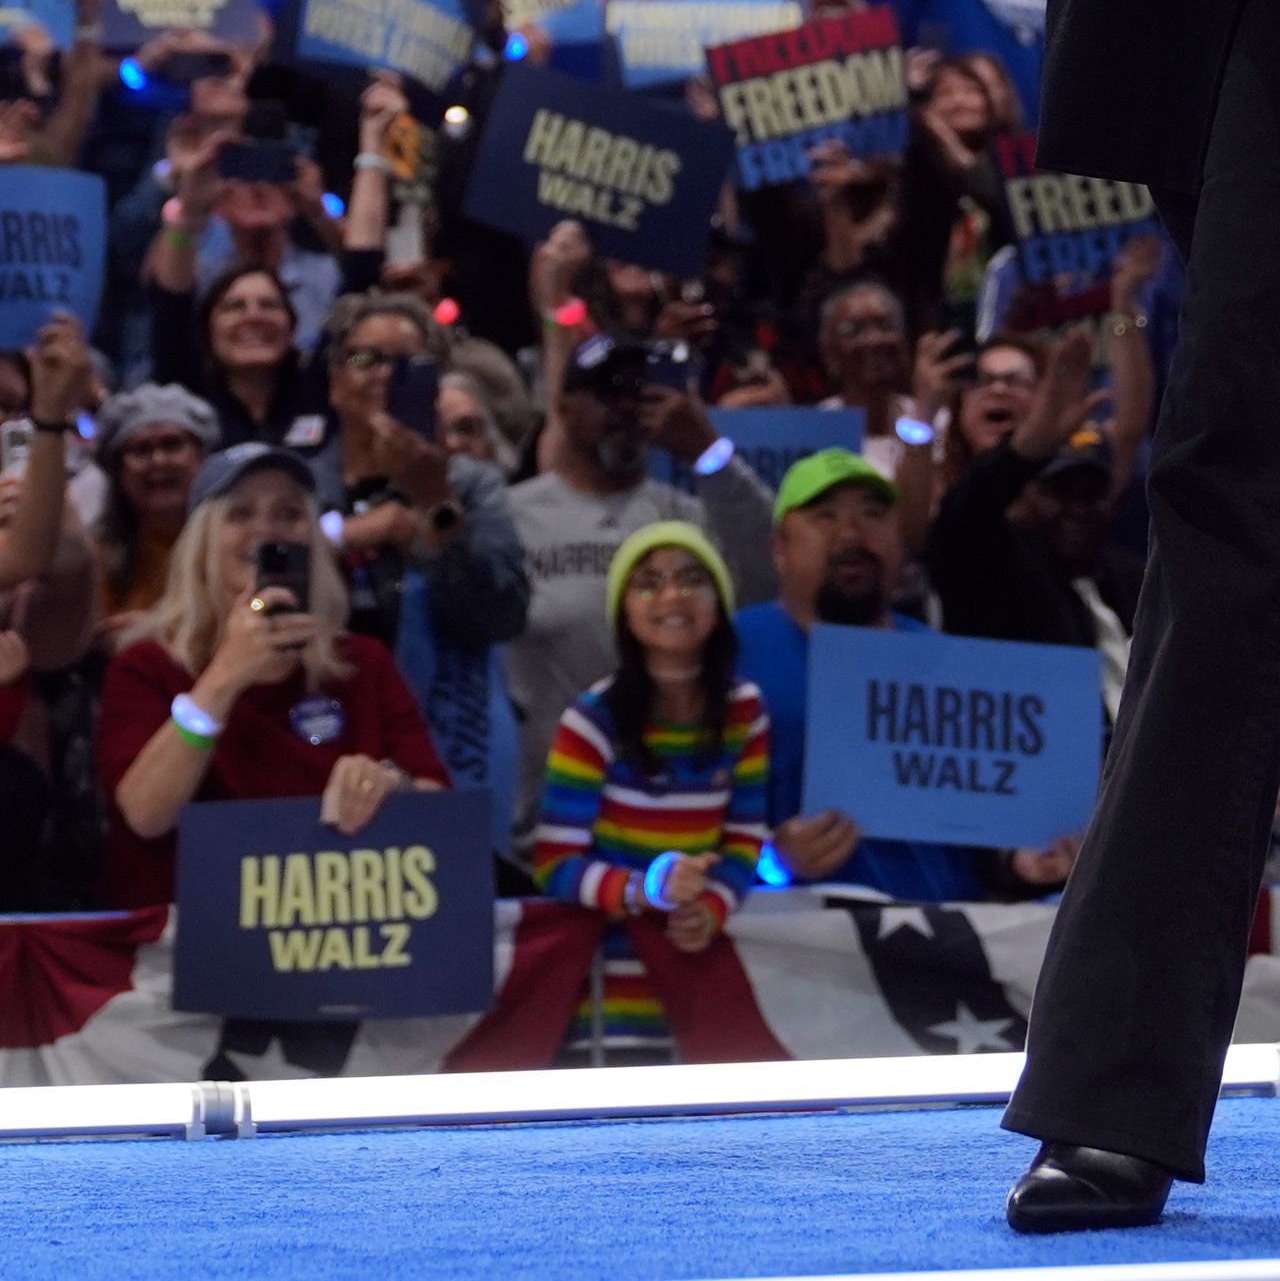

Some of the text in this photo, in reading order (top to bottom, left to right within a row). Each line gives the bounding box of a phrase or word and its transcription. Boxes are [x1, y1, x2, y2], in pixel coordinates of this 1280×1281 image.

[720, 45, 910, 147] FREEDOM
[523, 107, 682, 206] HARRIS
[537, 169, 645, 232] WALZ
[1005, 173, 1158, 240] FREED
[865, 678, 1046, 757] HARRIS
[892, 750, 1018, 796] WALZ
[239, 845, 439, 931] HARRIS
[269, 921, 413, 973] WALZ
